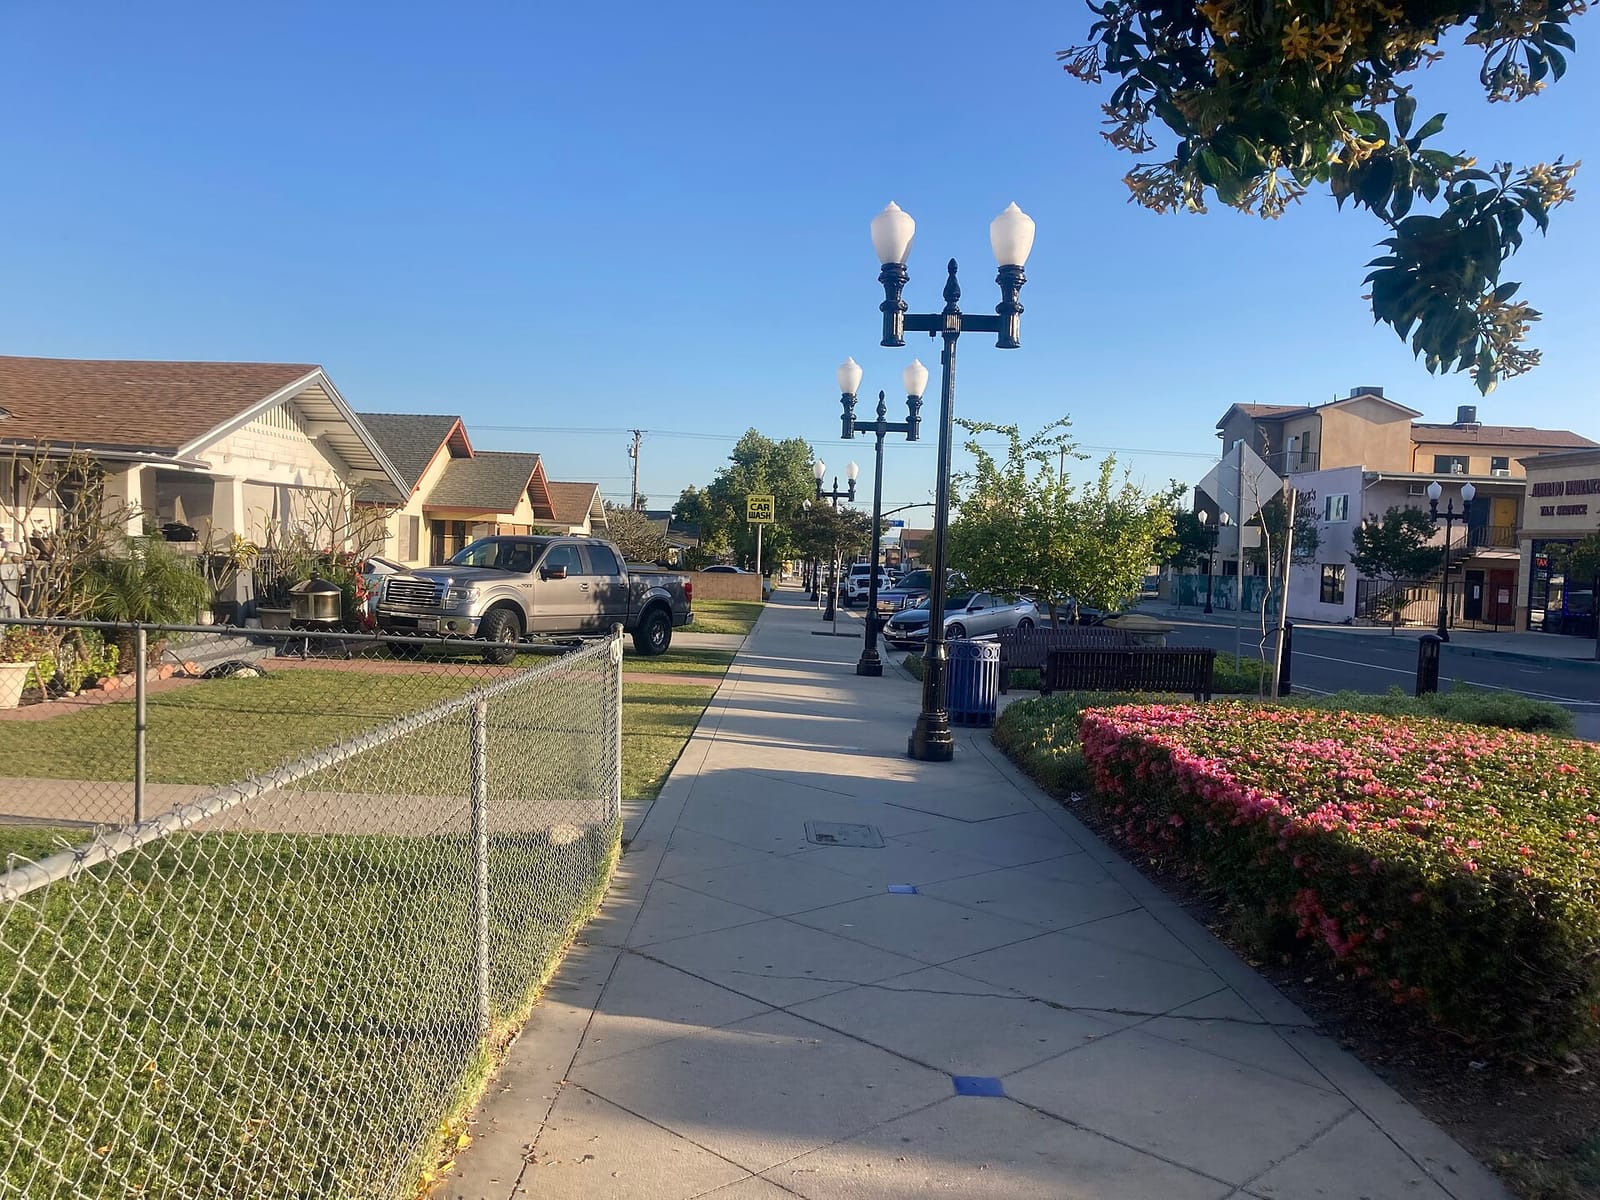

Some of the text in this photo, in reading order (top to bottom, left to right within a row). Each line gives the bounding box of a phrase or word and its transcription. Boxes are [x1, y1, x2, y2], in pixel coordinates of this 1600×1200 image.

[750, 503, 770, 511] CAR
[1540, 505, 1555, 516] TAX
[749, 511, 771, 519] WASH
